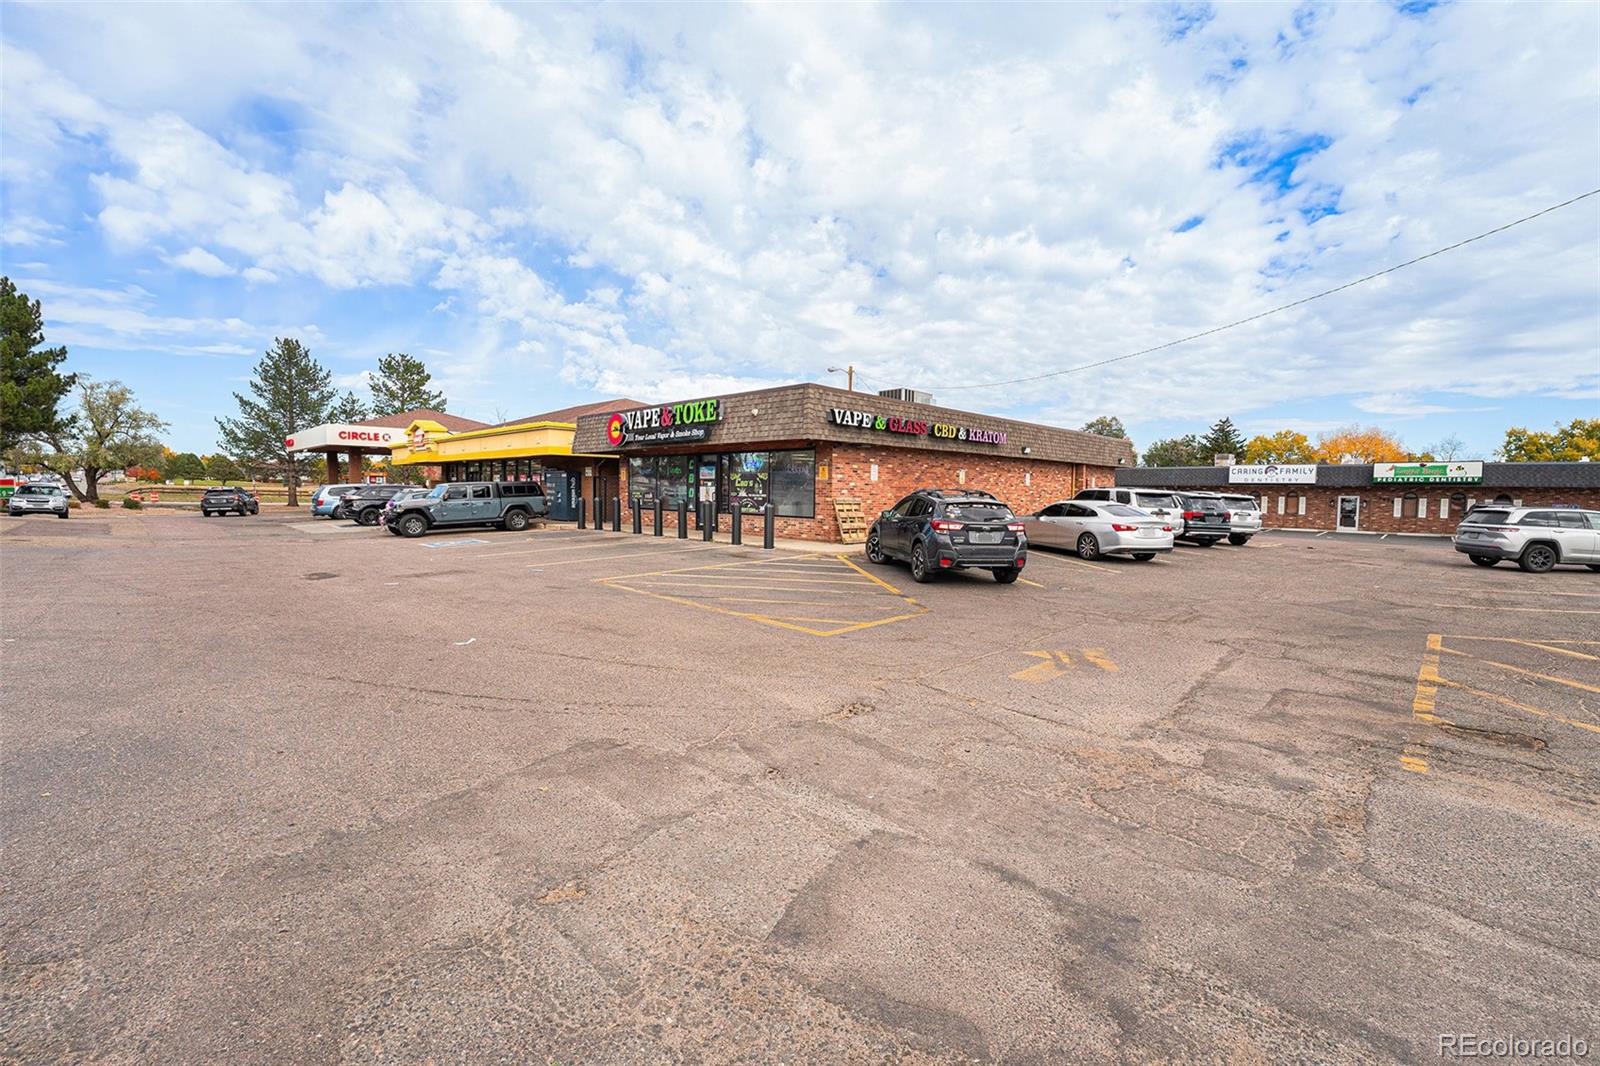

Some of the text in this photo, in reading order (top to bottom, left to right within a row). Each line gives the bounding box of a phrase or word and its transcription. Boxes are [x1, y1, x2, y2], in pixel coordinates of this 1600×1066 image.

[627, 399, 717, 430] VAPE & TOKE
[338, 431, 380, 441] CIRCLE
[833, 408, 1007, 444] VAPE & GLASS CBD & KRATOM
[1279, 467, 1314, 475] FAMILY
